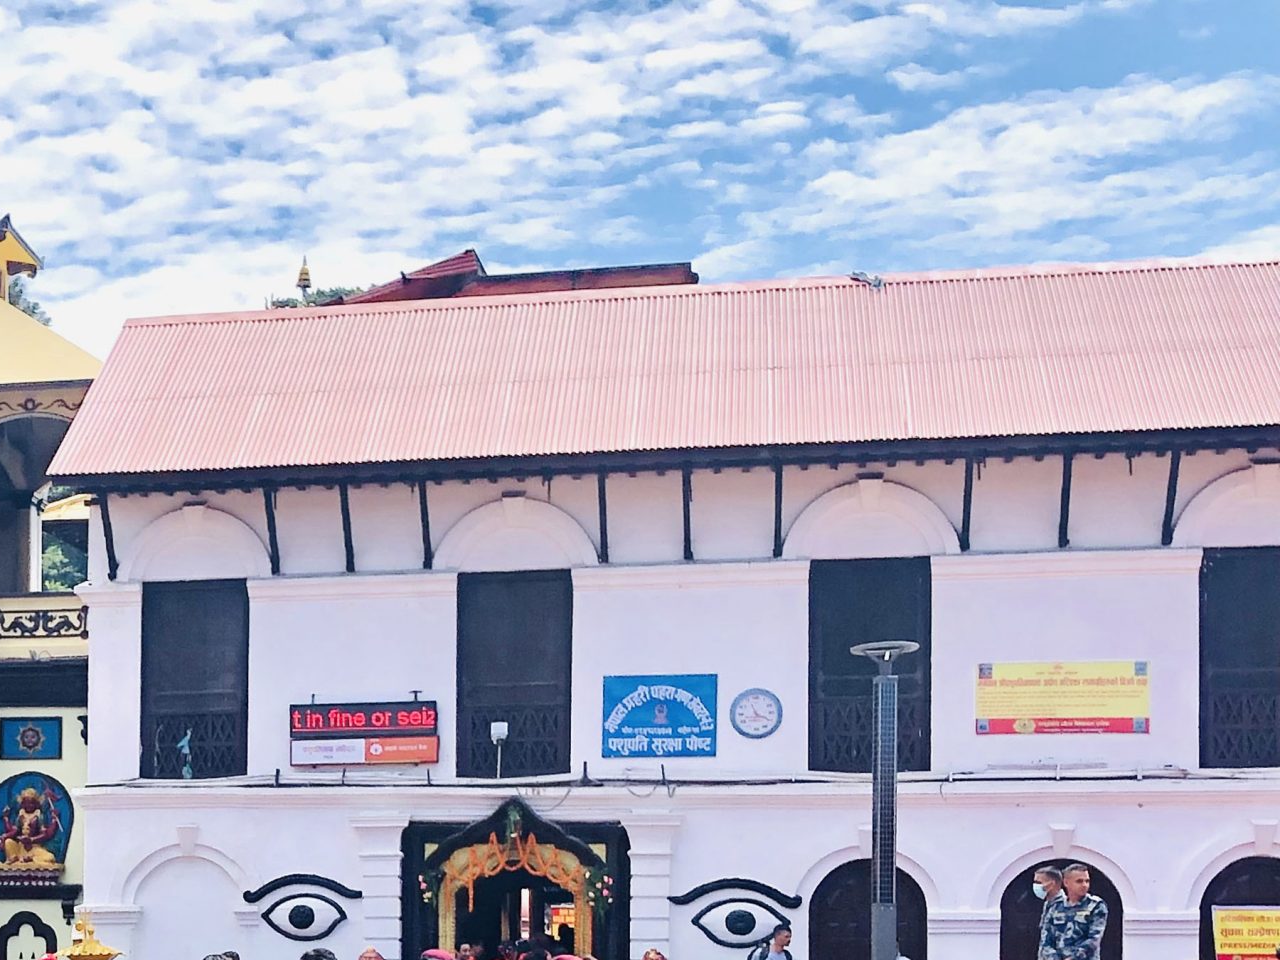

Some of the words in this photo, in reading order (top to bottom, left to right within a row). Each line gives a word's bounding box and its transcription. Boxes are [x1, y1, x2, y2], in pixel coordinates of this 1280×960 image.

[306, 709, 323, 728] in
[328, 708, 365, 728] fine
[371, 712, 391, 726] or
[397, 706, 435, 726] seiz
[608, 735, 649, 755] पशुपति
[651, 737, 682, 755] सुरक्षा
